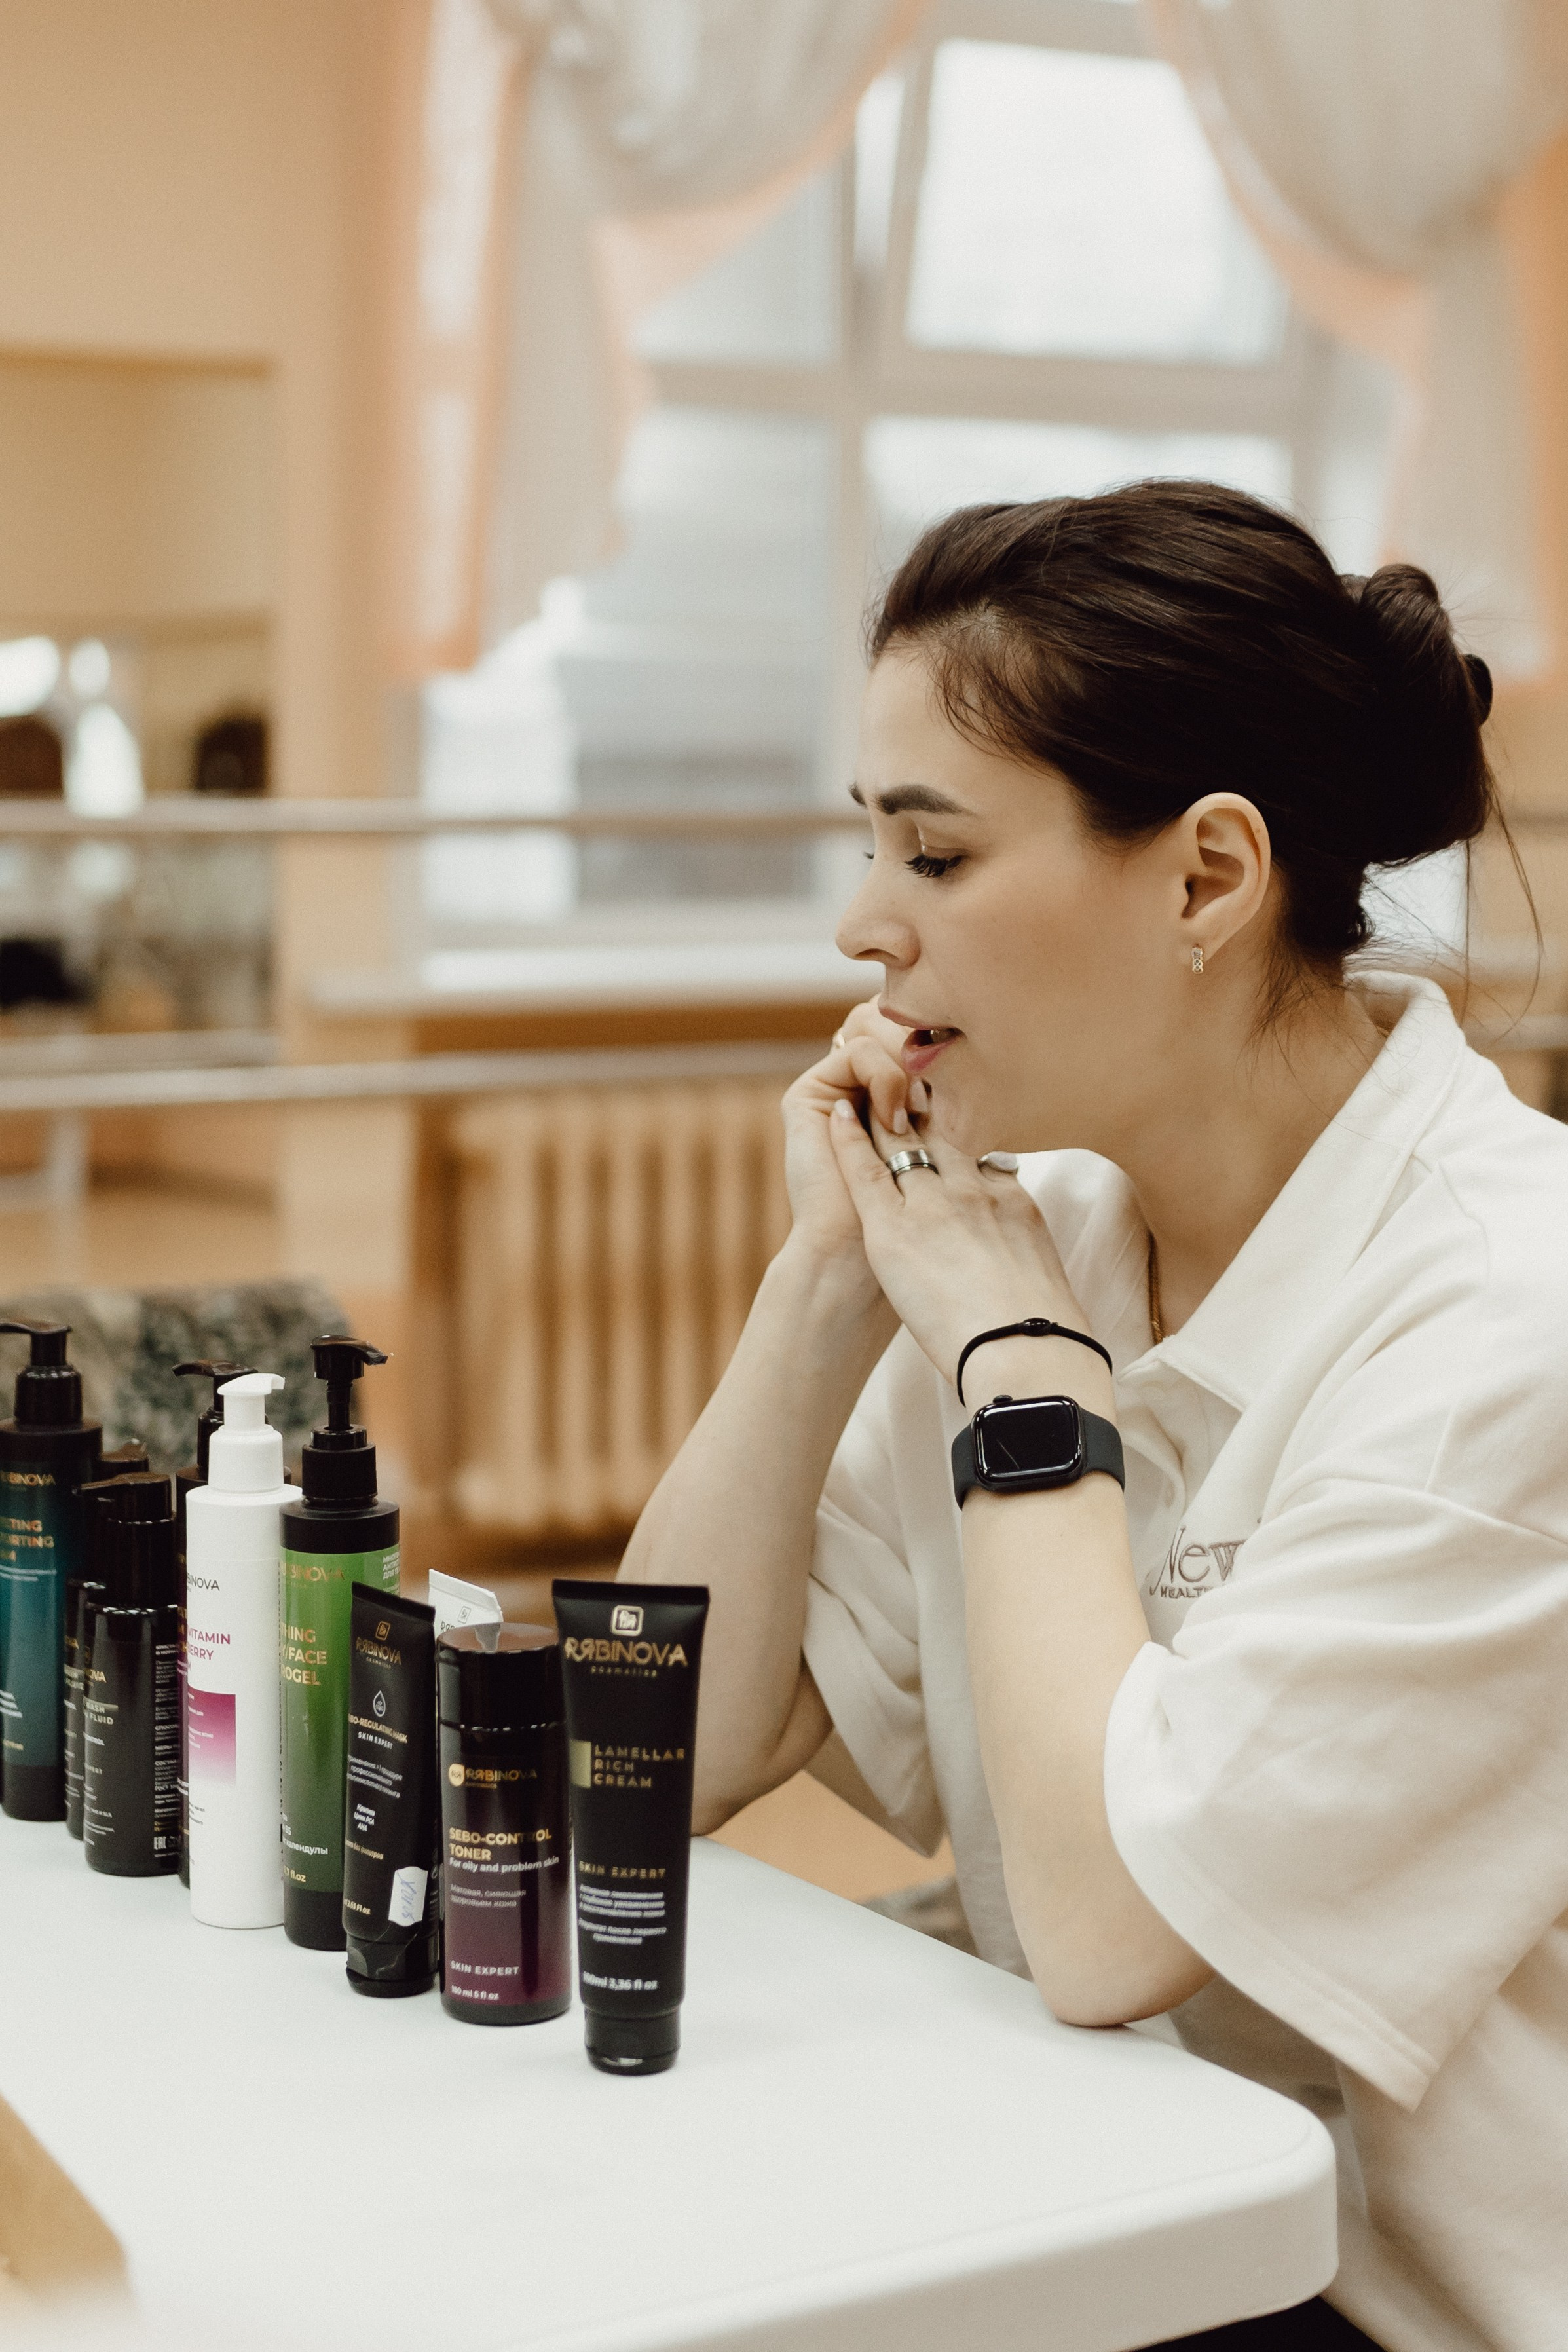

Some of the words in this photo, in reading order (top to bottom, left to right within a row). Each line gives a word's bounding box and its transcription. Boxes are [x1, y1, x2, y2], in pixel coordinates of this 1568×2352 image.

[358, 1730, 373, 1742] SKIN
[593, 1773, 652, 1788] CREAM
[449, 1842, 491, 1861] TONER
[449, 1856, 461, 1868] For
[462, 1861, 479, 1873] oily
[479, 1862, 499, 1873] and
[501, 1861, 543, 1875] problem
[544, 1856, 559, 1867] skin
[579, 1861, 605, 1876] SKIN
[611, 1867, 666, 1880] EXPERT
[451, 1960, 472, 1973] SKIN
[475, 1966, 519, 1976] EXPERT
[462, 1988, 472, 1998] ml
